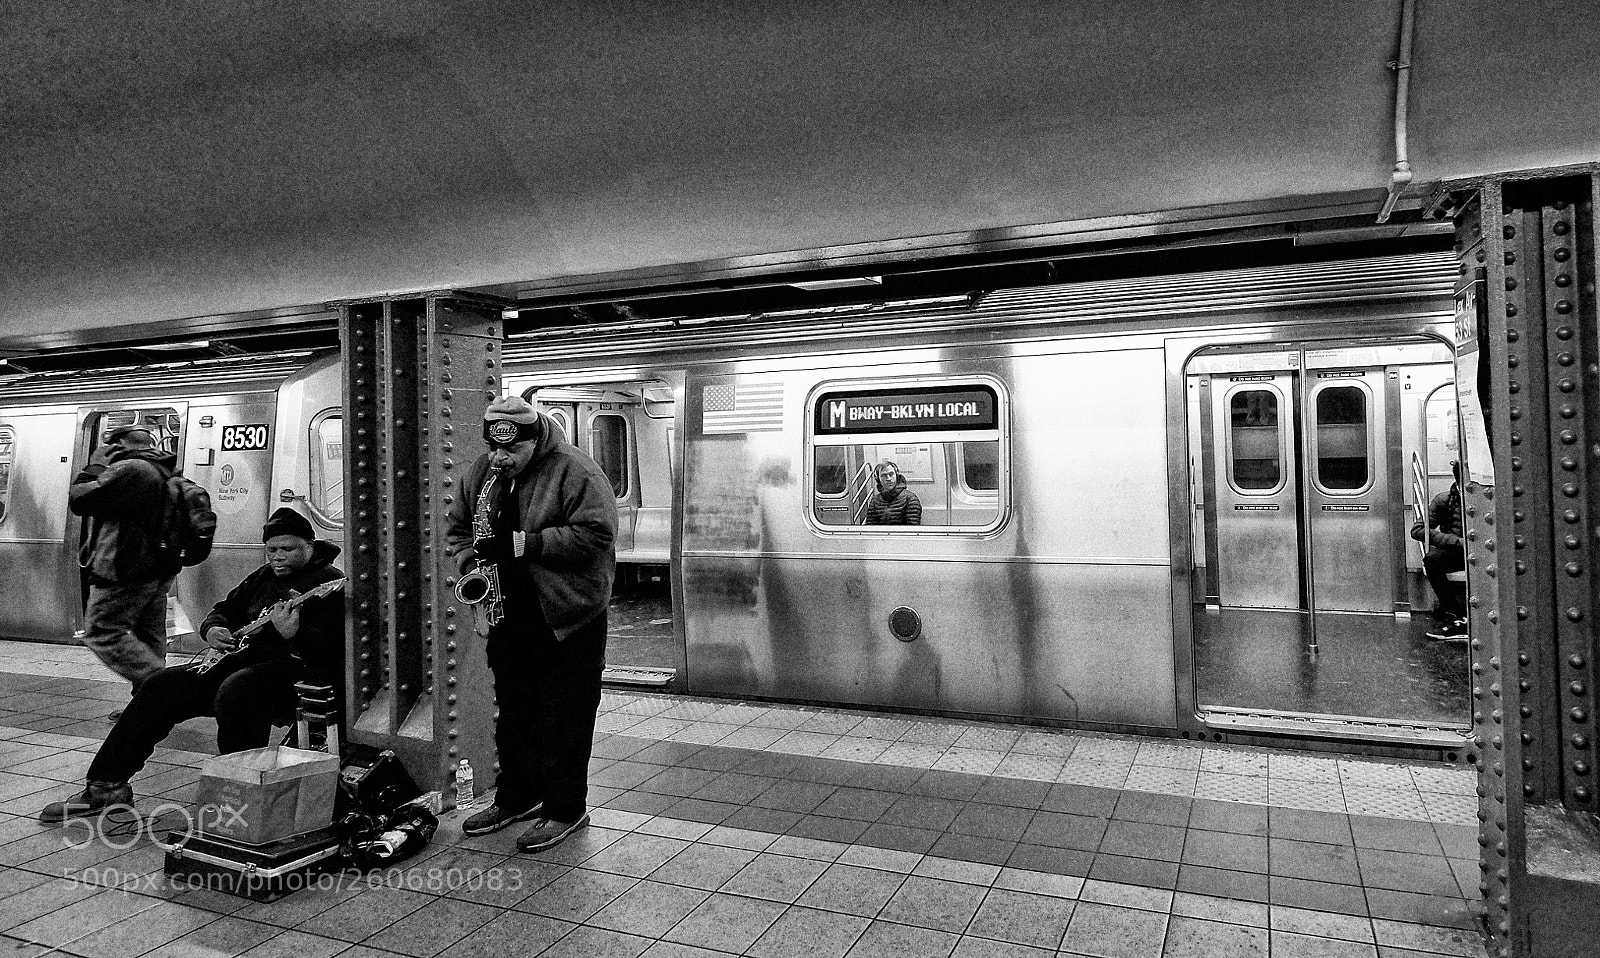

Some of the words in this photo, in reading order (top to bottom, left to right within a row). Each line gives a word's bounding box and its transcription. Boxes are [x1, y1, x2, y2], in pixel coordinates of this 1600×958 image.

[830, 401, 846, 428] M
[849, 403, 934, 421] BWAY-BKLYN
[938, 401, 980, 418] LOCAL
[224, 426, 267, 449] 8530
[240, 487, 249, 495] City
